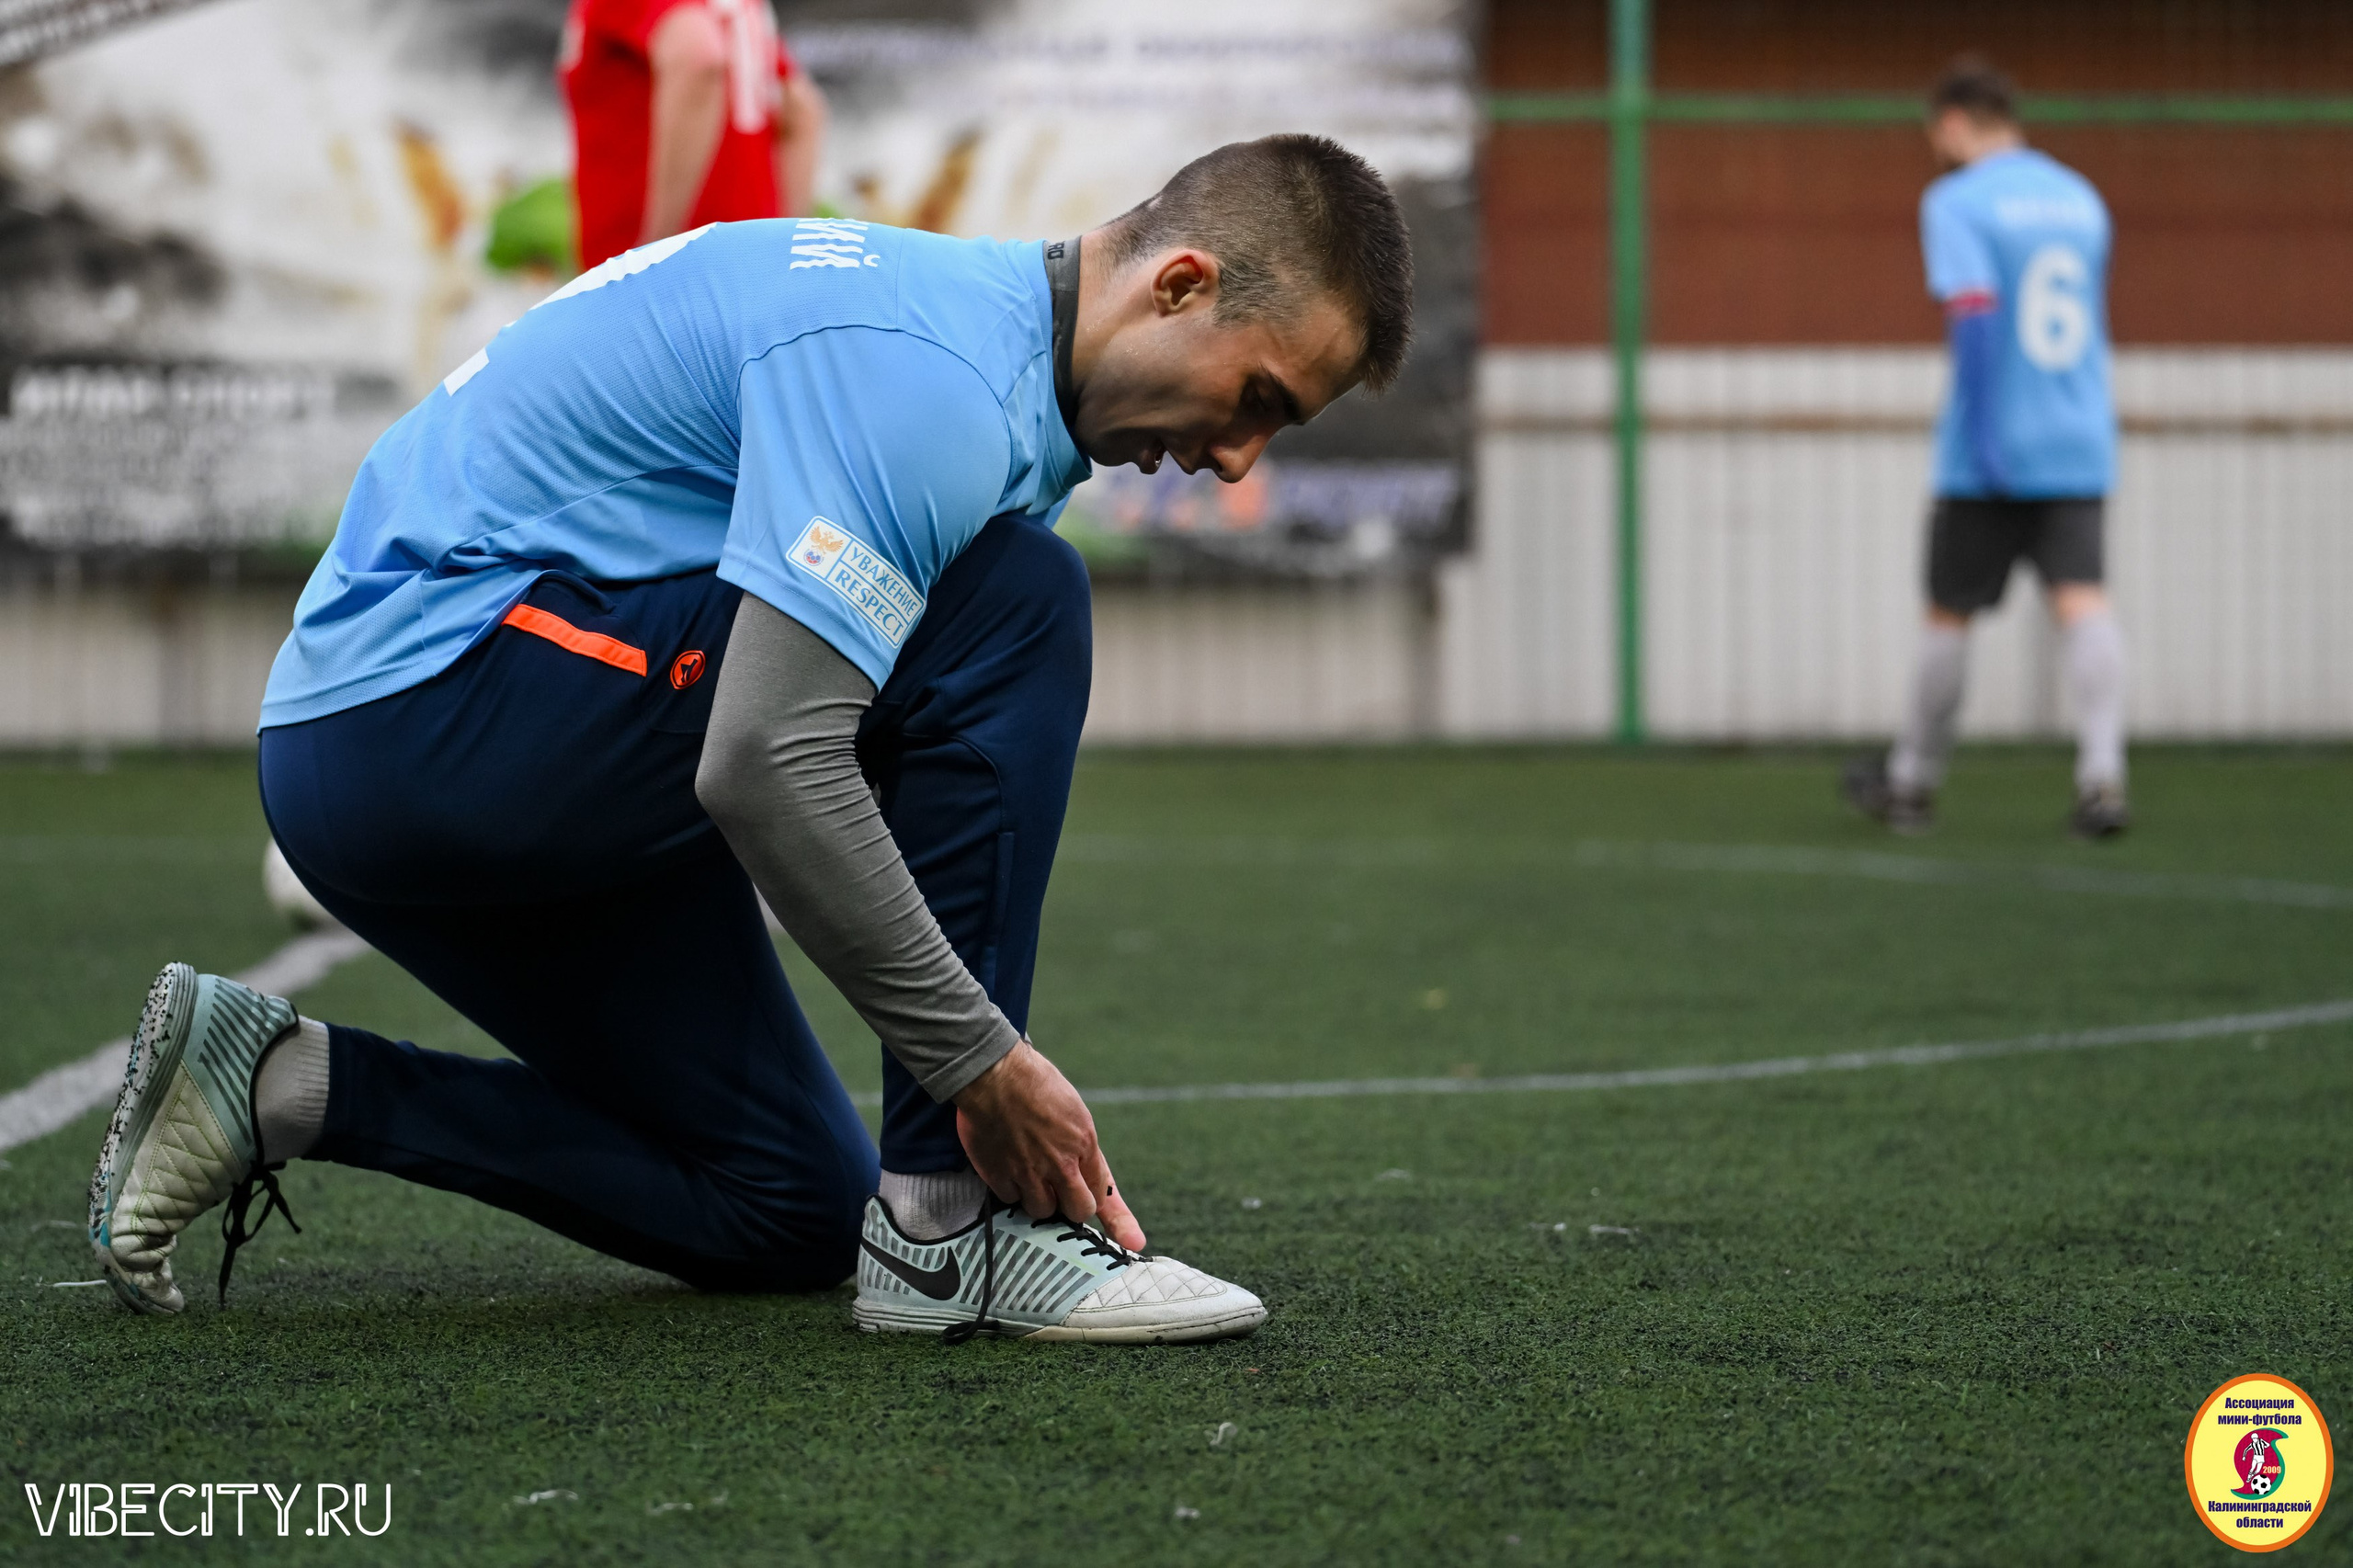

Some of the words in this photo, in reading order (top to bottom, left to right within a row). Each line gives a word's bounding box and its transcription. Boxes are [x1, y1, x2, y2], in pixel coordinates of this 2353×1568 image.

[790, 217, 881, 270] ИЙ
[2018, 245, 2086, 369] 6
[834, 568, 904, 637] RESPECT
[850, 546, 918, 617] УВАЖЕНИЕ
